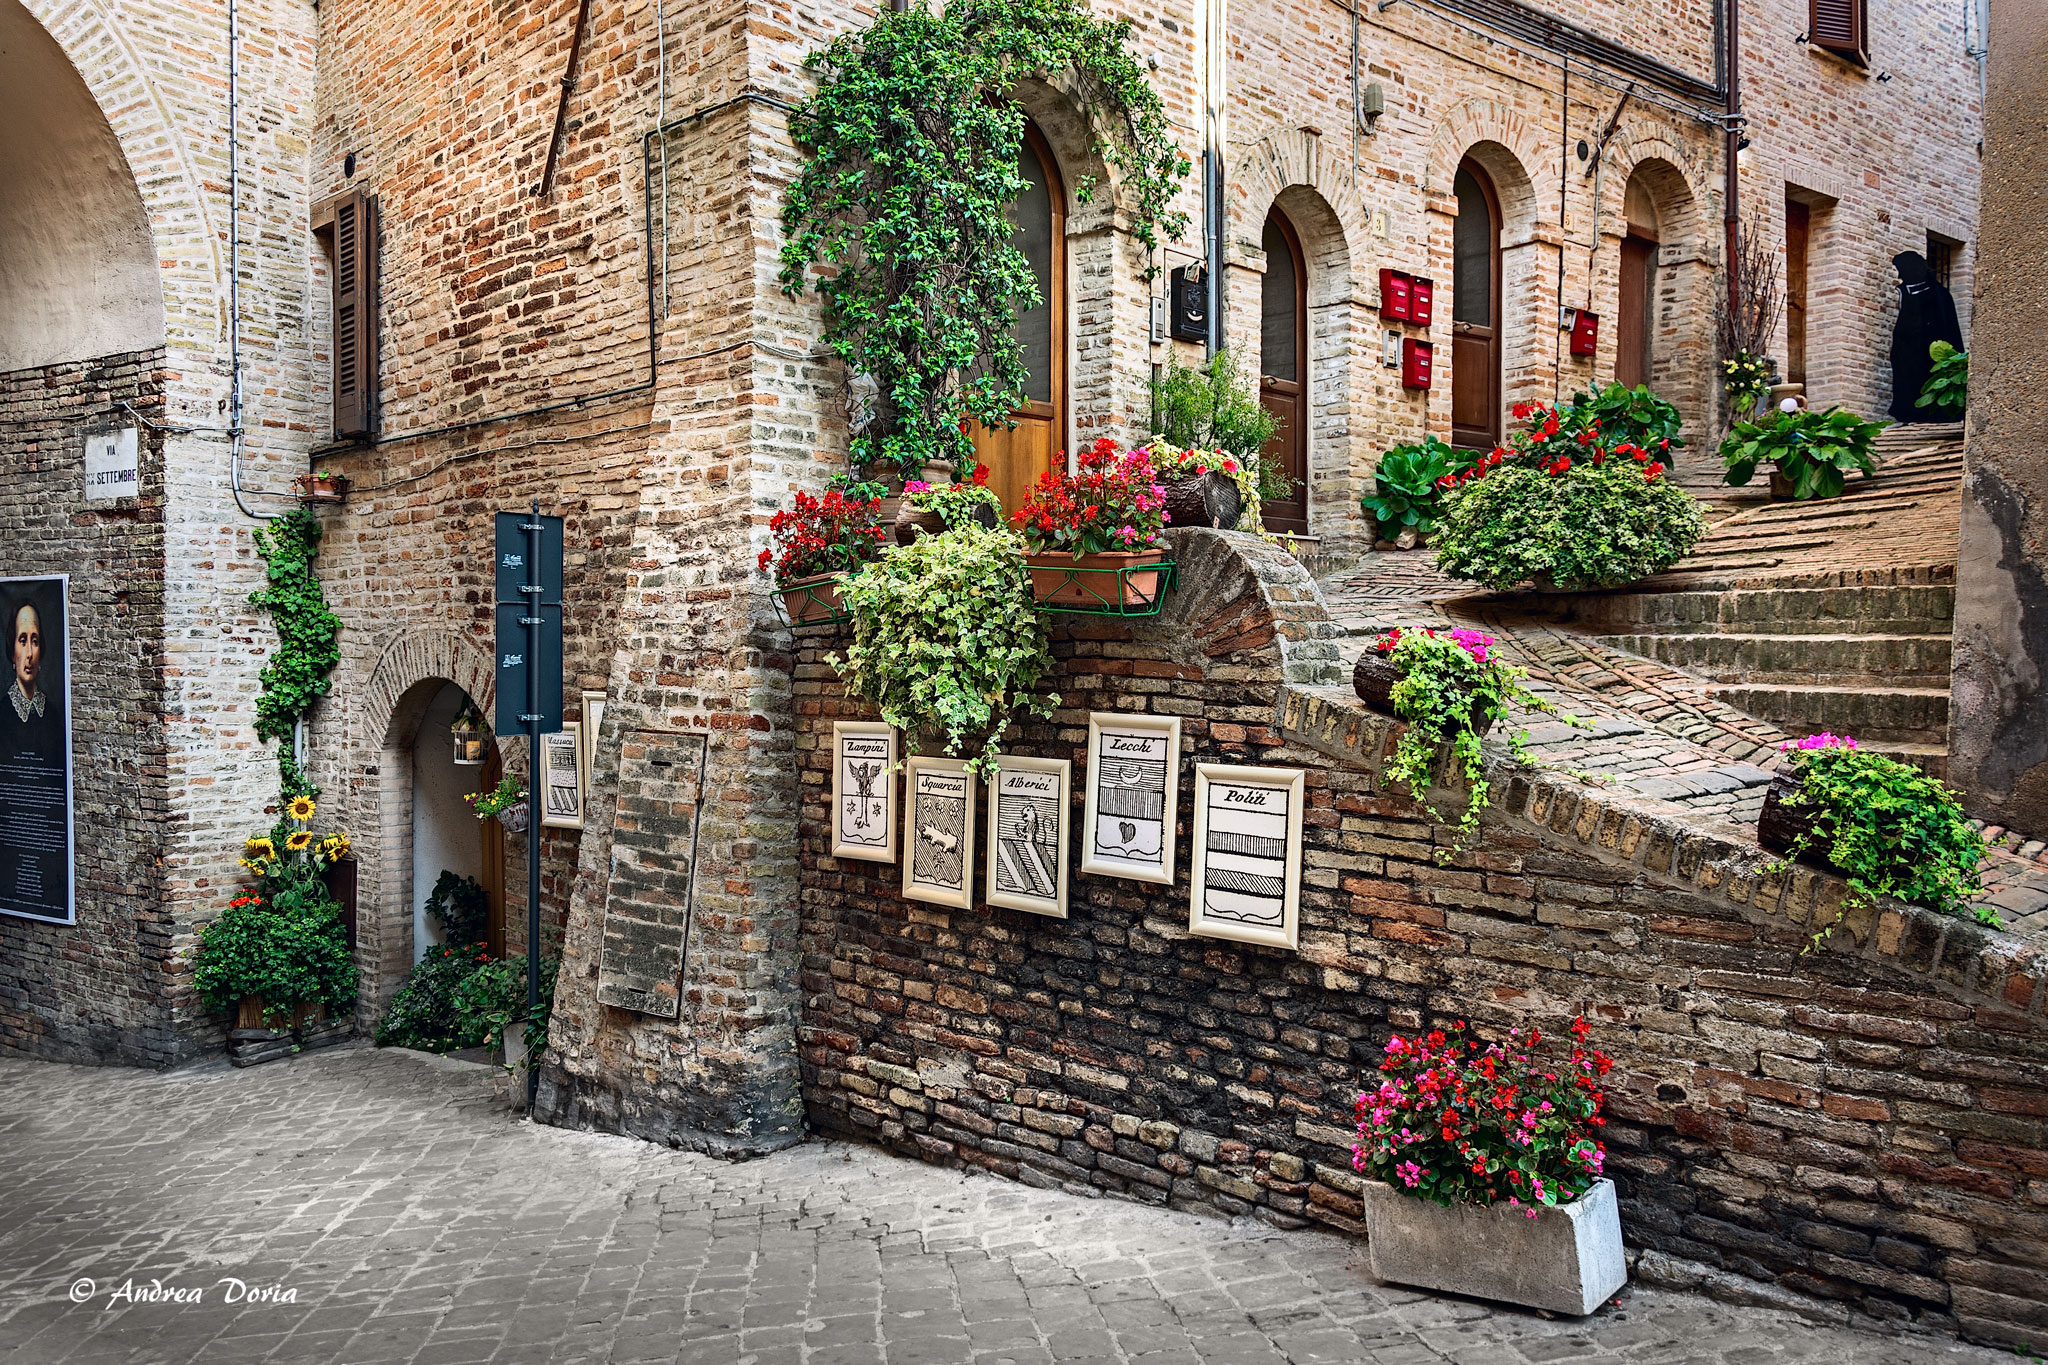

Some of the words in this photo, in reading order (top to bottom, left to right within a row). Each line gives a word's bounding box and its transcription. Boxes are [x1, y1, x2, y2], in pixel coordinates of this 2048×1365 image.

[106, 445, 116, 456] VIA
[96, 468, 137, 485] SETTEMBRE
[847, 741, 886, 755] Zampini
[1109, 738, 1156, 753] Lecchi
[921, 776, 963, 792] Squarcia
[1004, 776, 1052, 791] Alberici
[1224, 789, 1270, 806] Politi
